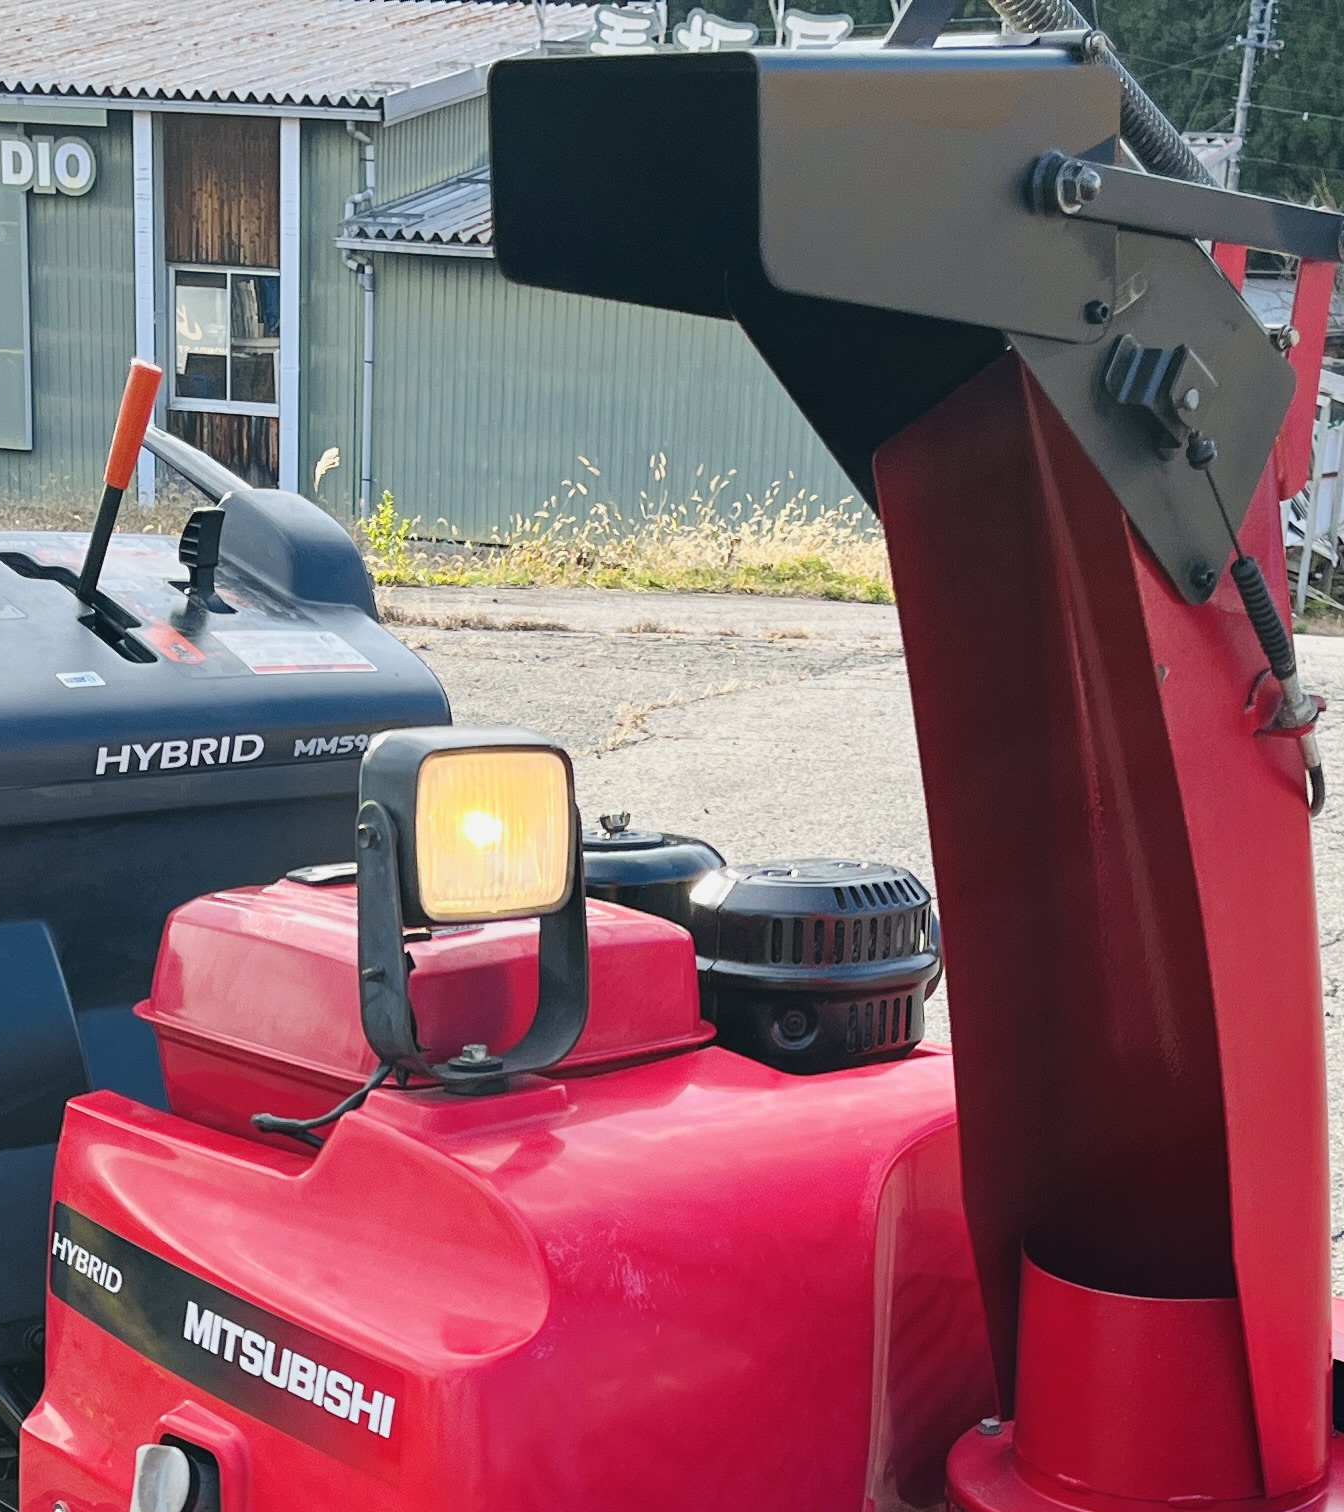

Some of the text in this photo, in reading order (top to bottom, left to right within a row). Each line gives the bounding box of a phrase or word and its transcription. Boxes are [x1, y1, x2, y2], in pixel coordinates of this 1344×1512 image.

[95, 734, 265, 775] HYBRID
[51, 1231, 124, 1294] HYBRID
[183, 1300, 396, 1439] MITSUBISHI
